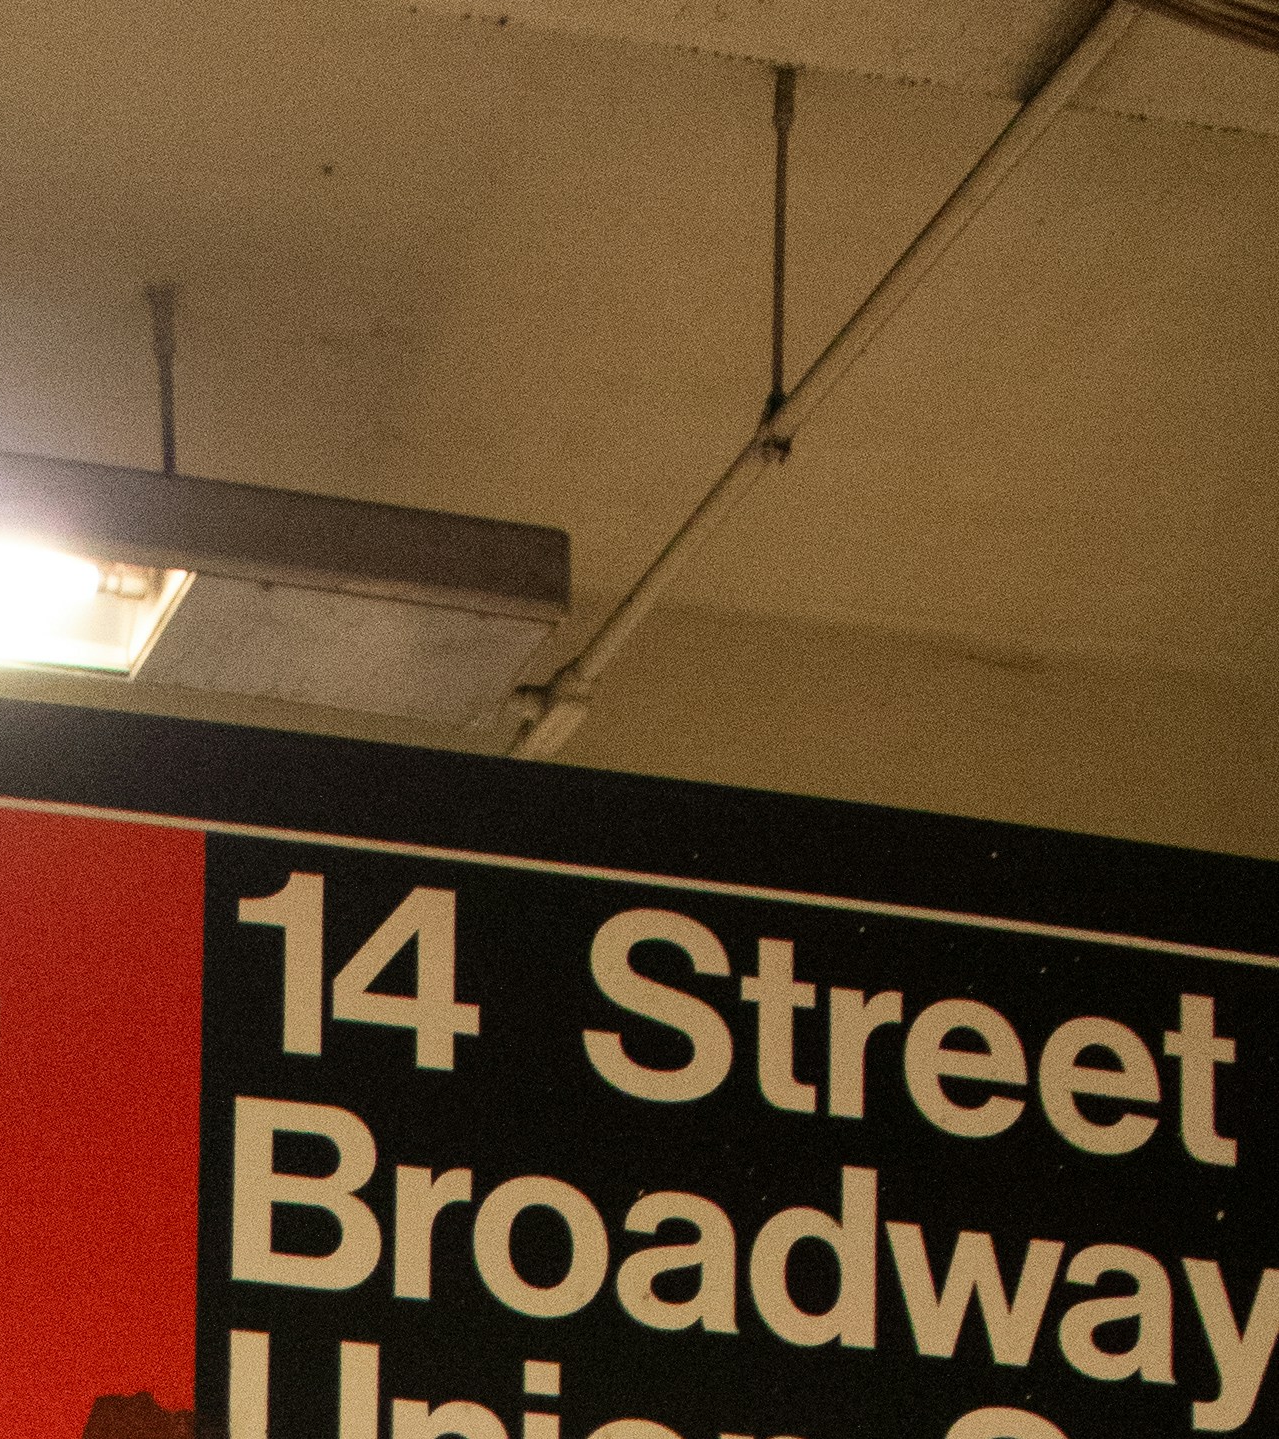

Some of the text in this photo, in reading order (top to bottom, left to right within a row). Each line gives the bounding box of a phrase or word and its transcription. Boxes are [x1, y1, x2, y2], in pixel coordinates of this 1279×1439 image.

[236, 870, 1237, 1167] 14 Street
[230, 1094, 1279, 1433] Broadway
